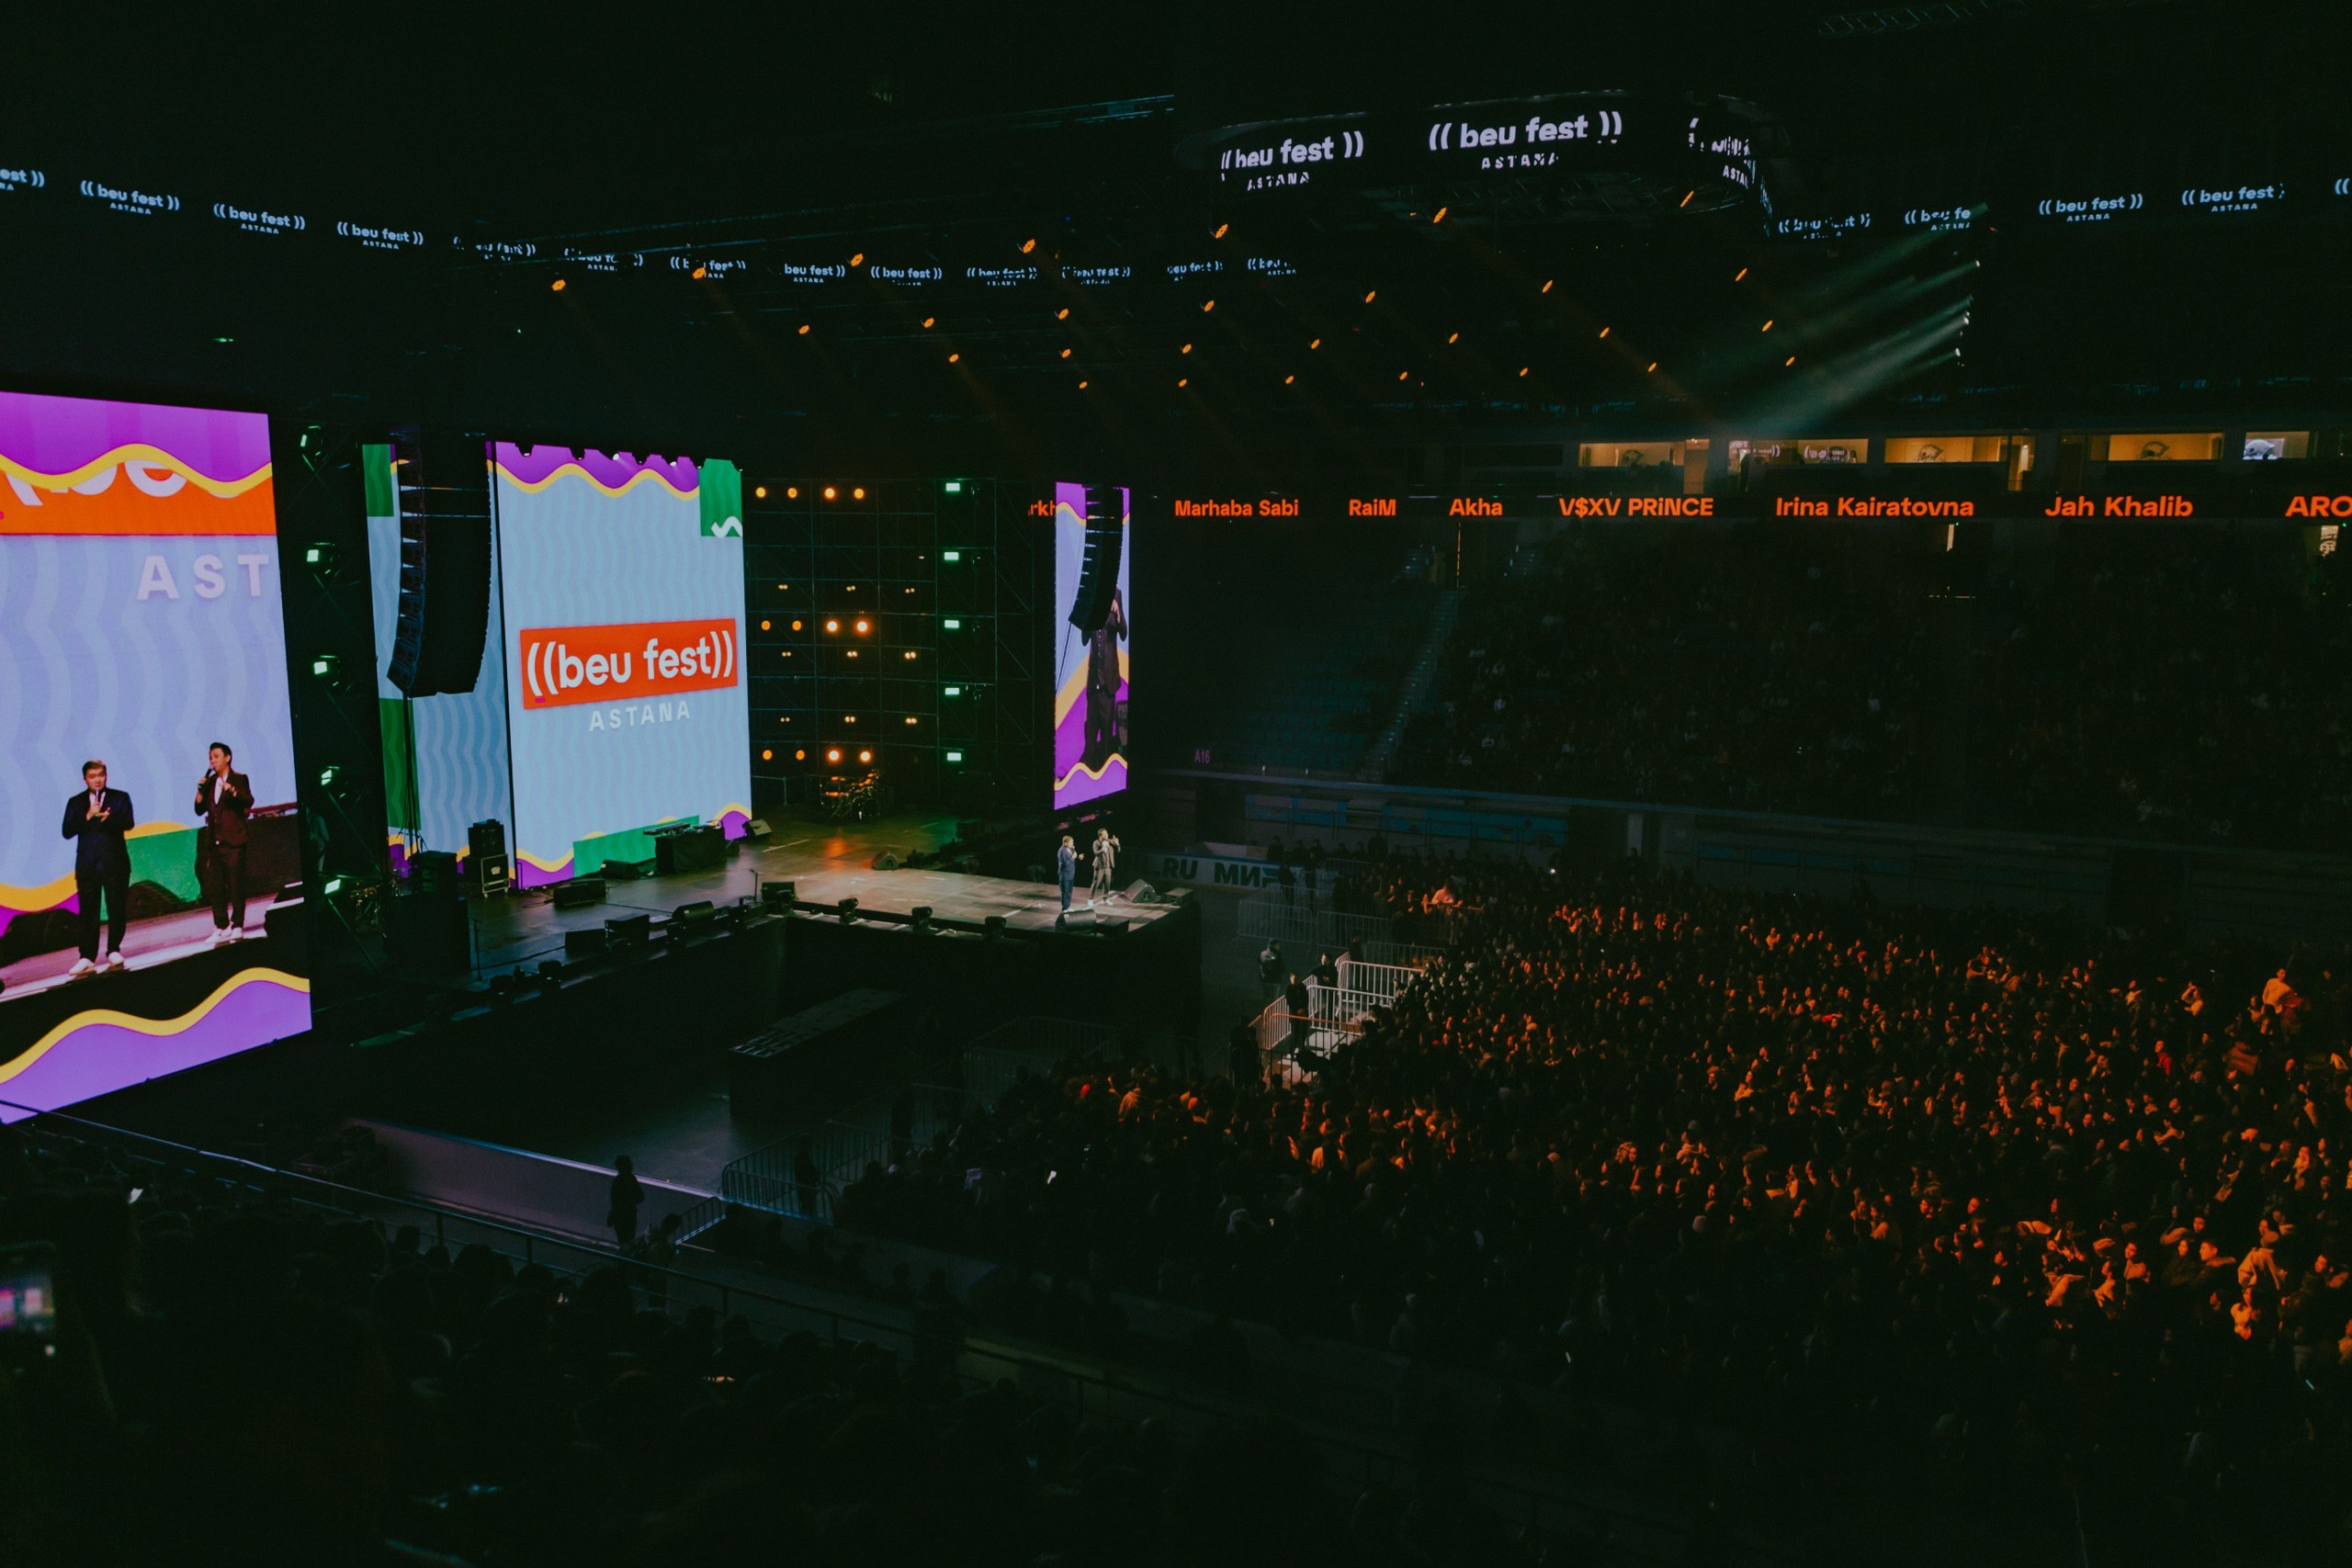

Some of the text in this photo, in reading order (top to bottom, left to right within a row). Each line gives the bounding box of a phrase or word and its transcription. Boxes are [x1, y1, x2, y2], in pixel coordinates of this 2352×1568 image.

[1460, 123, 1517, 149] beu
[1526, 115, 1589, 142] fest
[1280, 138, 1335, 164] fest
[97, 183, 129, 202] beu
[130, 189, 164, 209] fest
[2199, 189, 2233, 204] beu
[2237, 185, 2275, 200] fest
[109, 201, 153, 216] ASTANA
[2055, 199, 2087, 213] beu
[2091, 197, 2126, 210] fest
[2211, 203, 2258, 213] ASTANA
[229, 205, 258, 222] beu
[260, 210, 291, 228] fest
[2066, 212, 2110, 222] ASTANA
[240, 222, 280, 235] ASTANA
[351, 223, 379, 239] beu
[381, 228, 410, 243] fest
[362, 239, 400, 251] ASTANA
[784, 263, 808, 275] beu
[809, 265, 834, 276] fest
[882, 266, 905, 278] beu
[907, 267, 932, 279] fest
[1174, 499, 1299, 517] Marhaba Sabi
[1348, 499, 1396, 517] RaiM
[1449, 498, 1503, 517] Akha
[1559, 497, 1713, 518] V$XV PRiNCE
[1776, 497, 1974, 517] Irina Kairatovna
[2045, 495, 2193, 517] Jah Khalib
[589, 700, 690, 731] ASTANA
[1193, 749, 1210, 764] A16
